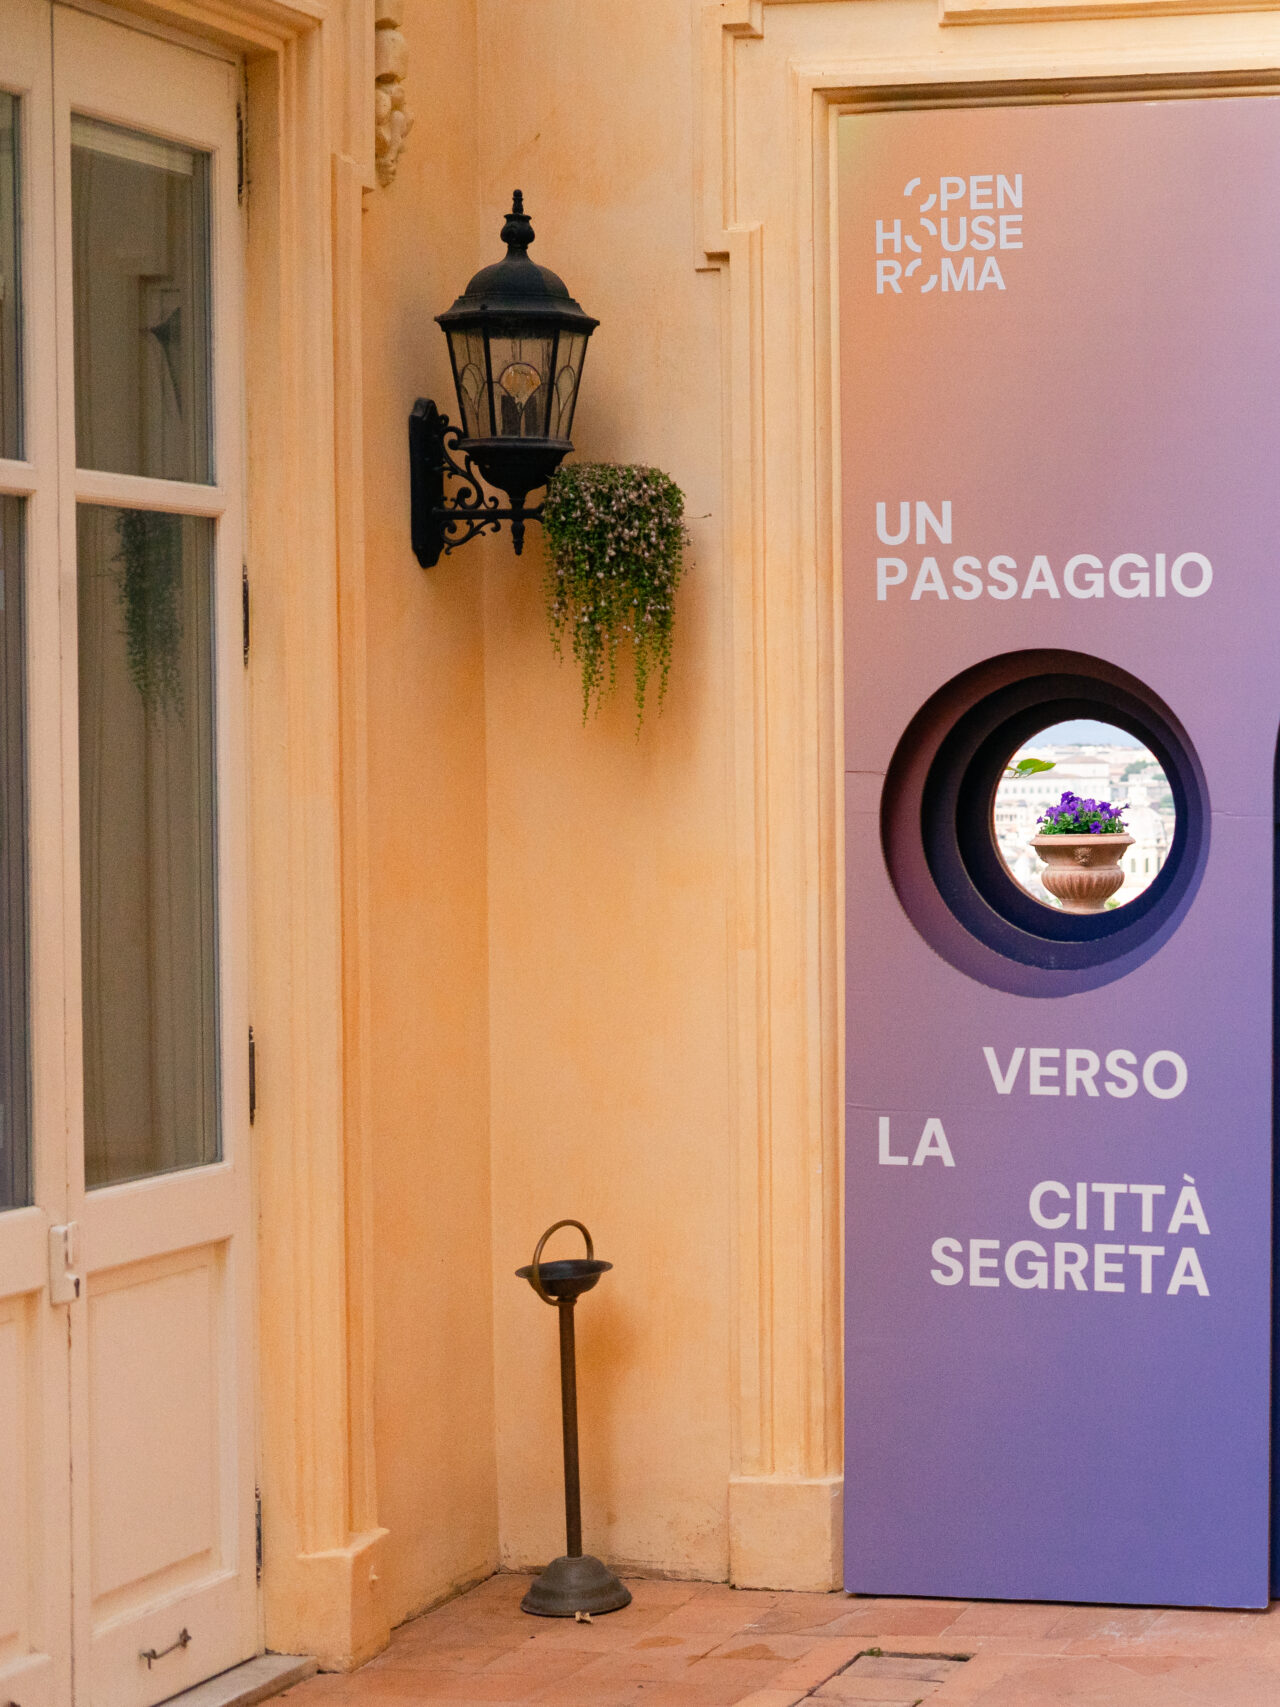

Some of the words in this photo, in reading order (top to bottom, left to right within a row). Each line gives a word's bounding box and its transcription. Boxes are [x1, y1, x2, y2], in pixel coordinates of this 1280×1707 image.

[903, 173, 1023, 213] OPEN
[875, 214, 1024, 255] HOUSE
[876, 255, 1008, 294] ROMA
[876, 500, 952, 546] UN
[876, 551, 1214, 602] PASSAGGIO
[983, 1047, 1188, 1099] VERSO
[878, 1116, 955, 1167] LA
[1029, 1174, 1210, 1236] CITTÀ
[930, 1237, 1210, 1297] SEGRETA
